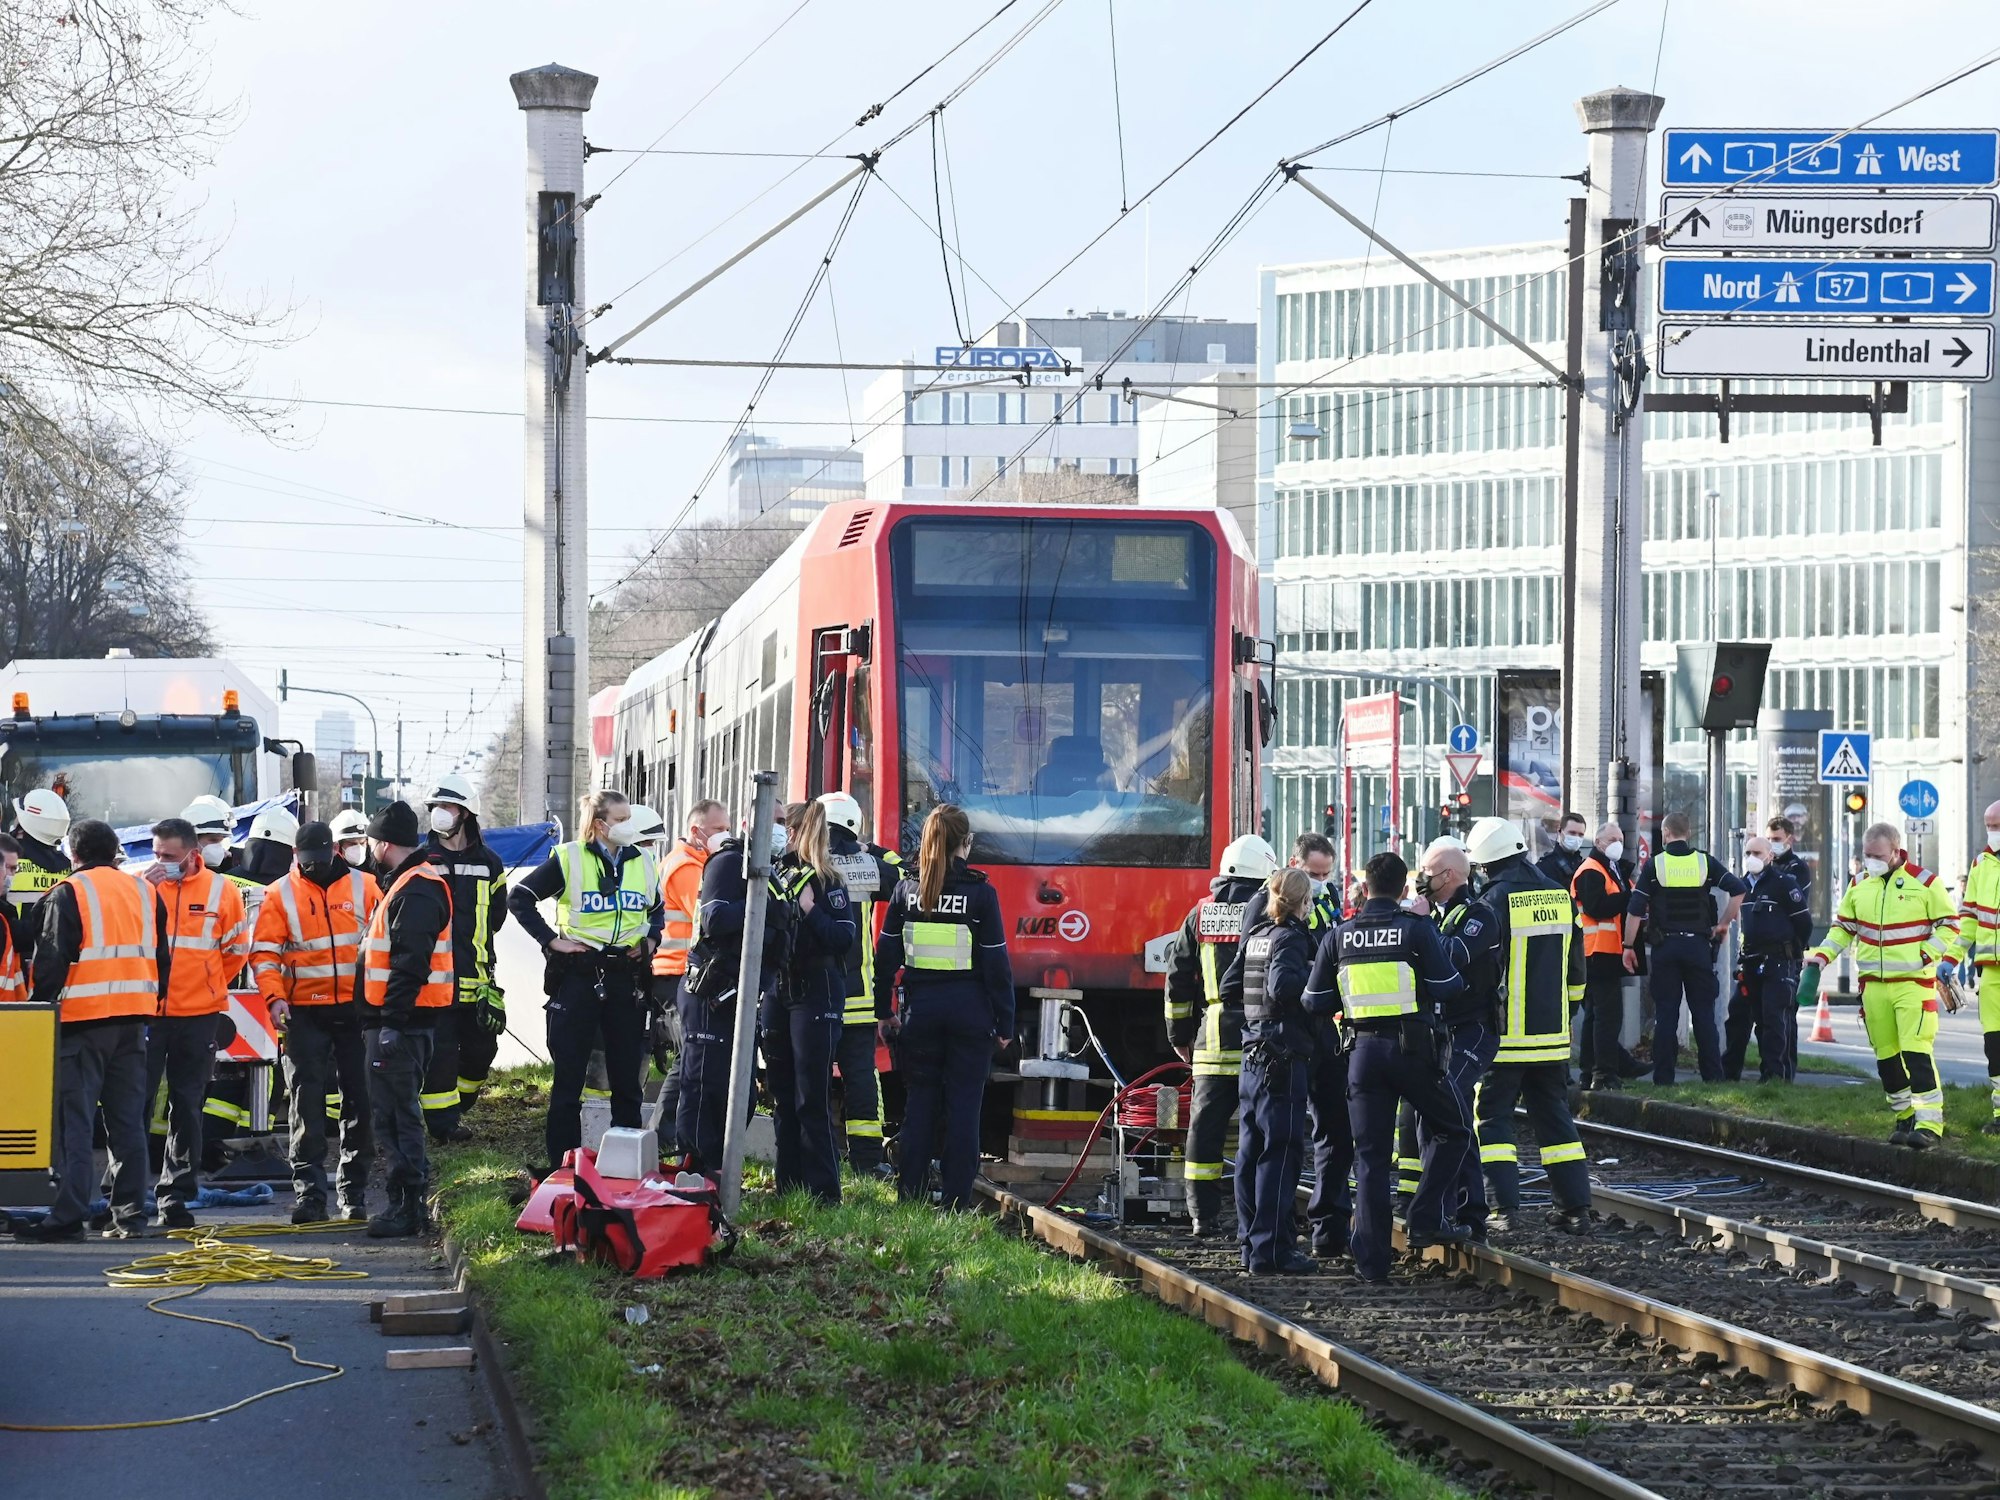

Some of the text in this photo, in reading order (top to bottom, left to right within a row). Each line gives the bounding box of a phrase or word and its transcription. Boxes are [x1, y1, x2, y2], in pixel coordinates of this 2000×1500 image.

[1746, 146, 1961, 172] 1 4 West
[1766, 209, 1923, 239] Müngersdorf
[1703, 274, 1911, 299] Nord 57 1
[936, 347, 1060, 367] EUROPA
[1806, 338, 1930, 363] Lindenthal
[1526, 705, 1560, 741] p
[846, 870, 877, 881] ERWEHR
[1668, 867, 1697, 878] POLIZEI
[907, 893, 967, 914] POIZEI
[1510, 893, 1570, 909] BERUFSFEUERWEHR
[1533, 906, 1558, 923] KÖLN
[1015, 917, 1058, 935] KVB
[1343, 928, 1402, 949] POLIZEI
